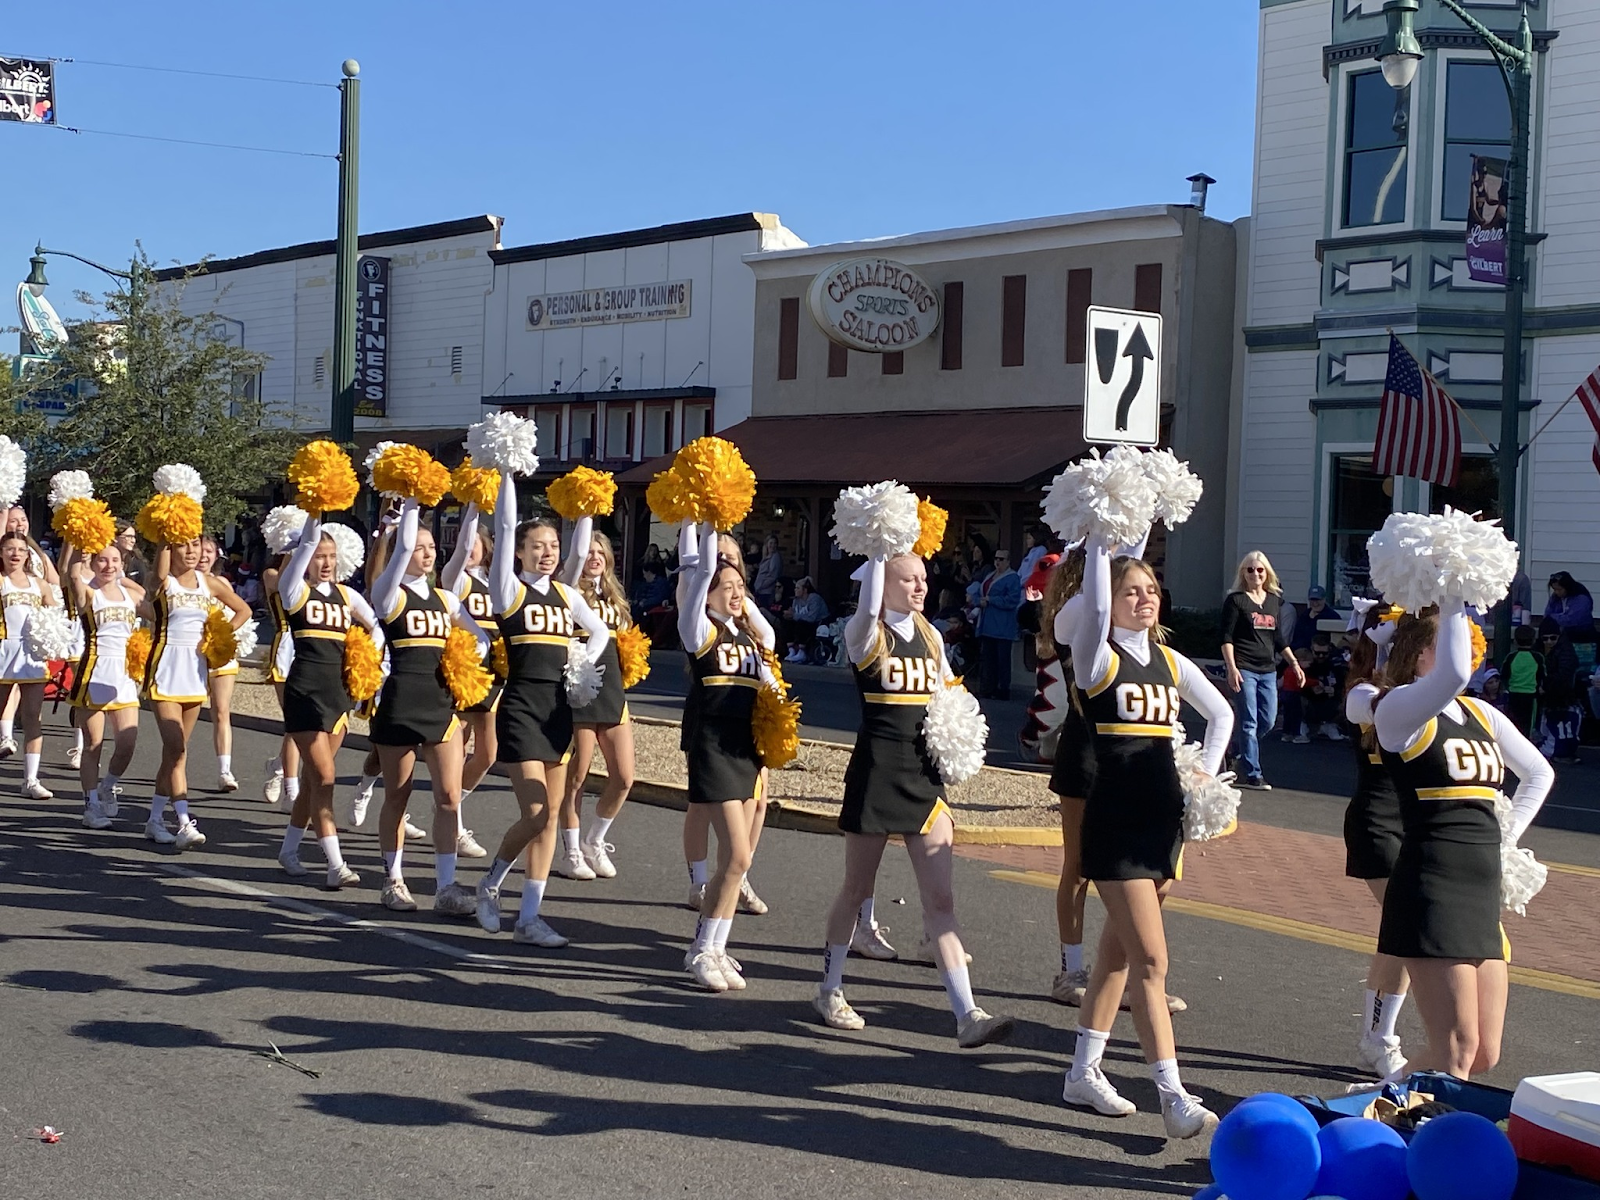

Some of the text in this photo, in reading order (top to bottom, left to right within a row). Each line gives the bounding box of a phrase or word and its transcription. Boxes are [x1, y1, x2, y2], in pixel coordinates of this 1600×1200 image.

[1467, 224, 1504, 248] Learn
[1471, 259, 1503, 273] GILBERT
[546, 283, 685, 316] PERSONAL & GROUP TRAINING
[827, 264, 936, 313] CHAMPIONS
[854, 294, 909, 316] SPORTS
[647, 309, 677, 317] NUTRITION
[838, 309, 919, 345] SALOON
[365, 282, 386, 400] FITNESS
[306, 600, 351, 629] GHS
[406, 609, 452, 638] GHS
[524, 603, 574, 636] GHS
[717, 642, 761, 675] GH
[880, 656, 939, 692] GHS
[1116, 682, 1181, 724] GHS
[1556, 720, 1574, 740] 11
